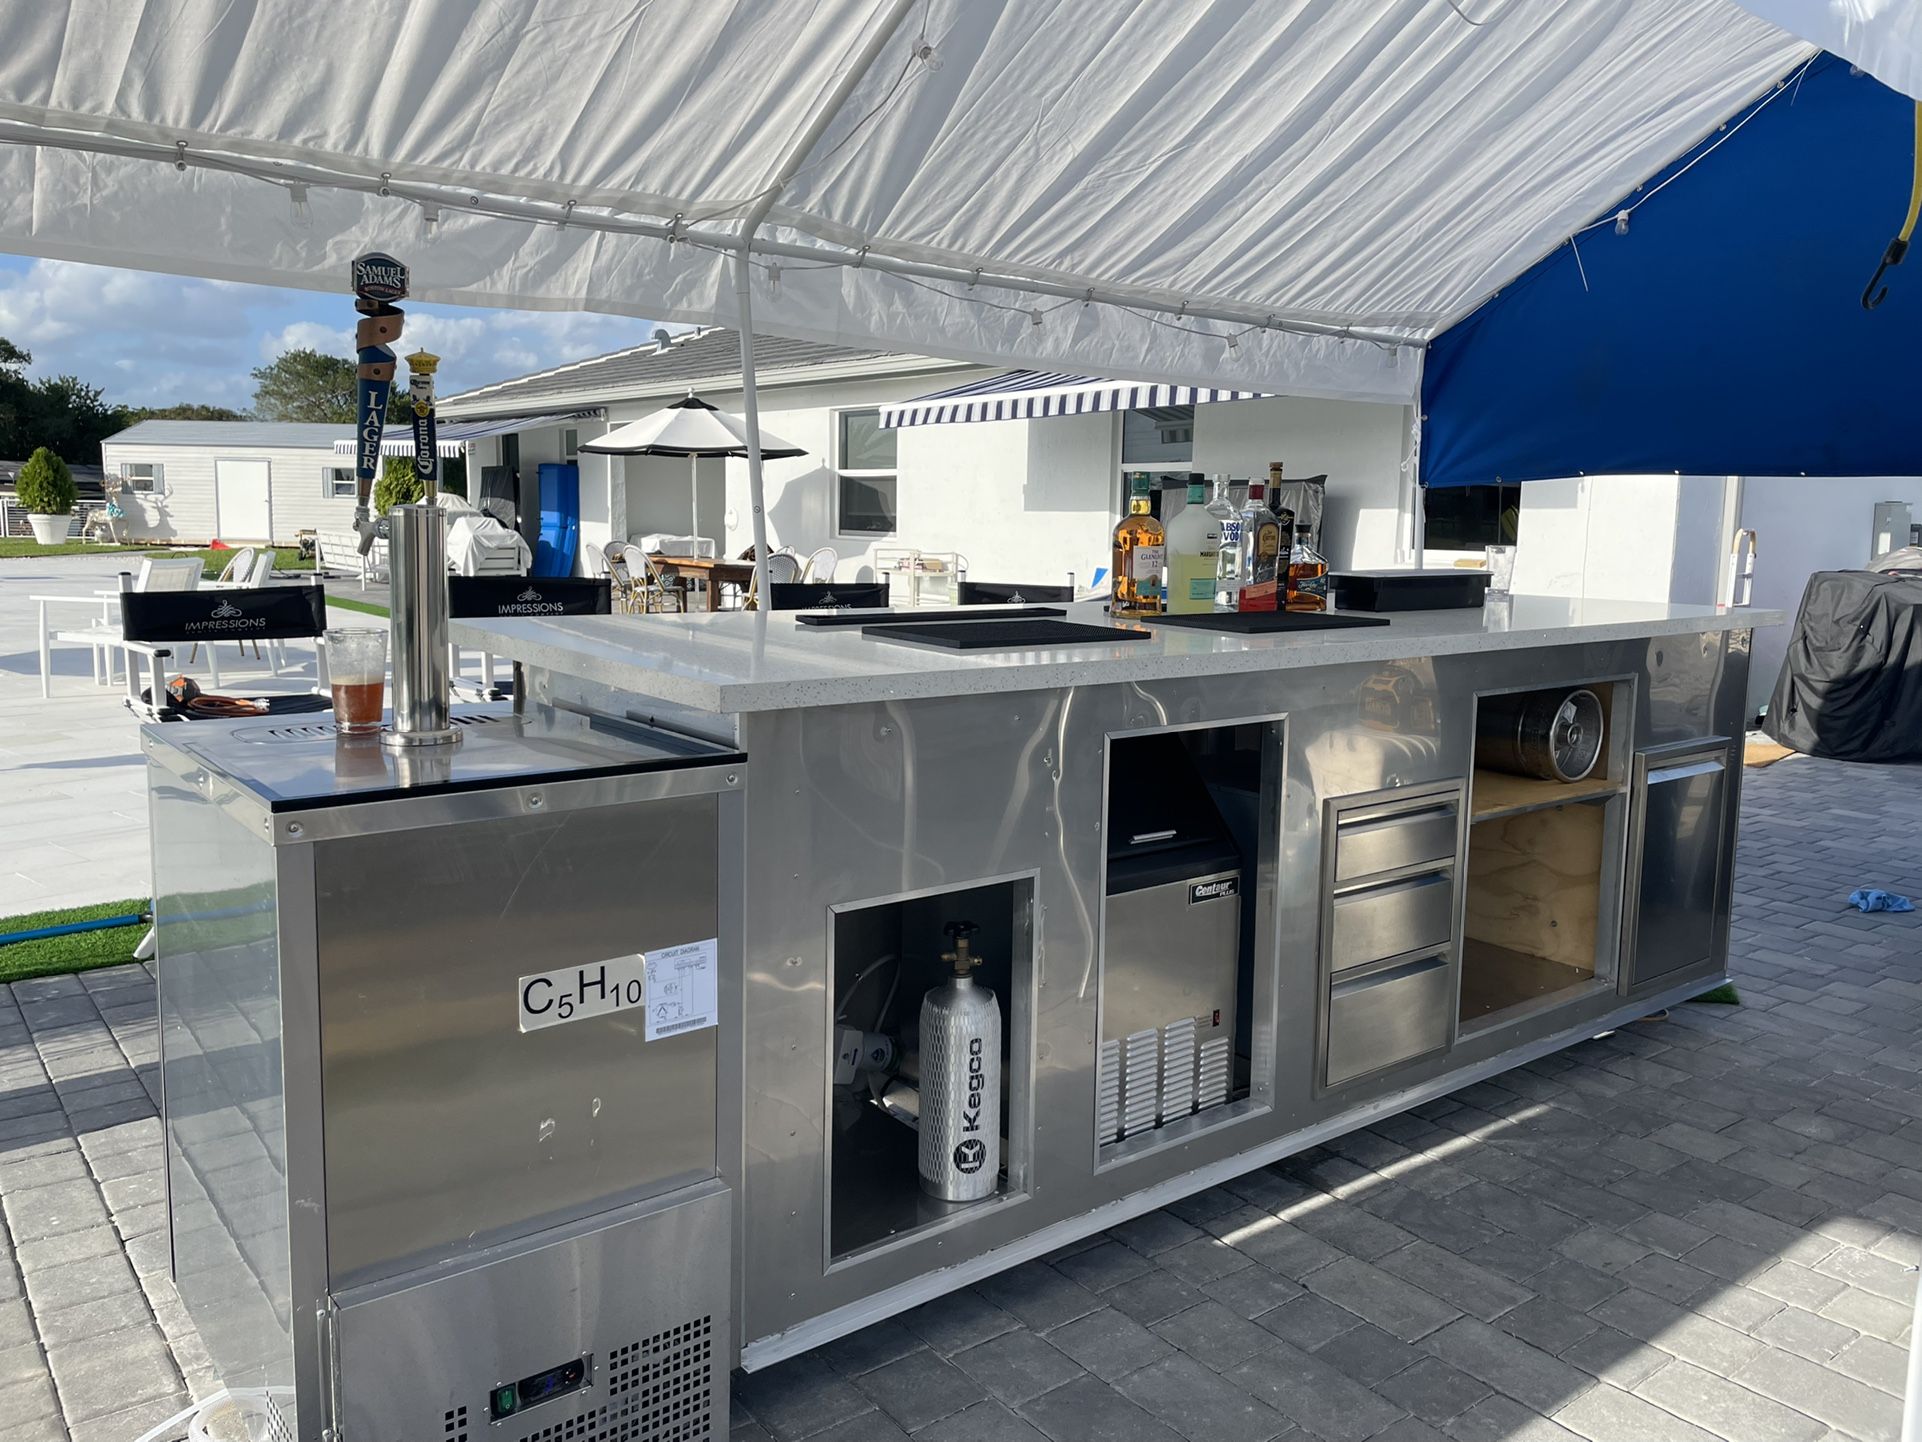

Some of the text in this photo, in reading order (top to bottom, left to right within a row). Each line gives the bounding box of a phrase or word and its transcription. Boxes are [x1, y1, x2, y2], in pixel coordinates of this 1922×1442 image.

[356, 262, 405, 279] SAMUEL
[360, 274, 402, 289] ADAMS
[362, 390, 383, 470] LAGER
[417, 418, 435, 475] Corona
[1151, 560, 1158, 568] 12
[498, 602, 564, 615] IMPRESSIONS
[184, 617, 266, 631] IMPRESSIONS
[1195, 882, 1231, 897] Centaur
[661, 946, 700, 959] CIRCUIT DIAGRAM
[962, 1037, 985, 1133] Kegco
